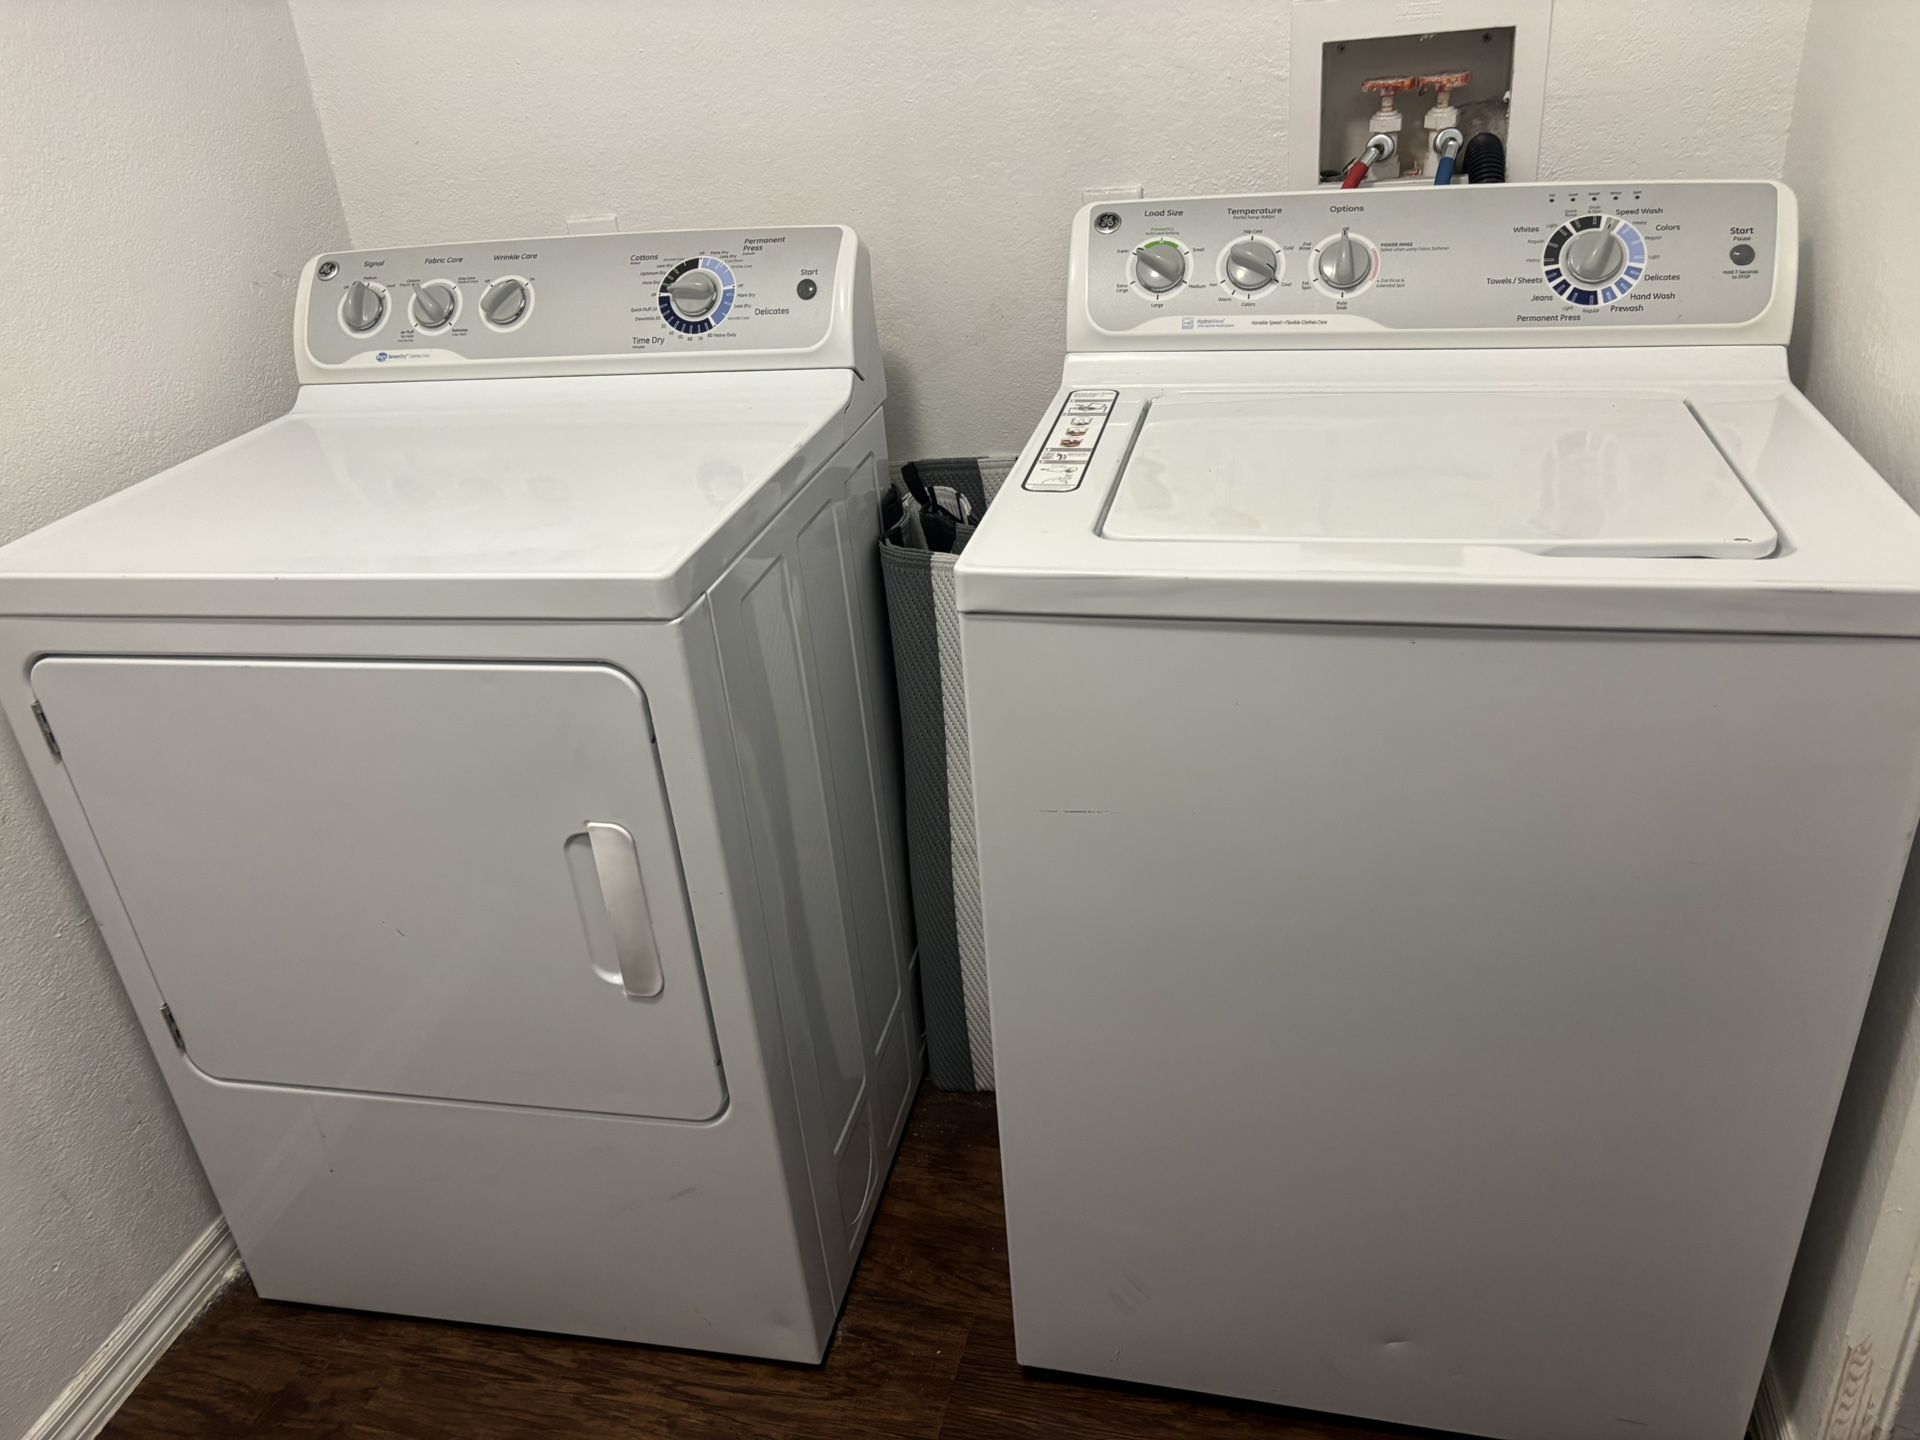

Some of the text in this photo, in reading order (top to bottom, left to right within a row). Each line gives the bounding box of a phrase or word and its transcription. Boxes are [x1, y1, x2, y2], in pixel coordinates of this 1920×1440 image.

[1167, 209, 1184, 217] Size
[1227, 207, 1283, 216] Temperature
[1330, 205, 1364, 213] Options
[1615, 207, 1664, 216] Speed Wash
[1730, 226, 1754, 235] Start
[744, 236, 785, 245] Permanent
[446, 256, 463, 264] Care
[493, 252, 538, 261] Wrinkle Care
[364, 260, 385, 268] Signal
[1487, 277, 1512, 285] Towels
[1518, 276, 1543, 284] Sheets
[1644, 273, 1681, 281] Delicates
[1531, 294, 1554, 302] Jeans
[1630, 291, 1675, 300] Hand Wash
[755, 307, 790, 316] Delicates
[1610, 304, 1644, 312] Prewash
[1516, 314, 1559, 322] Permanent
[651, 336, 665, 345] Dry
